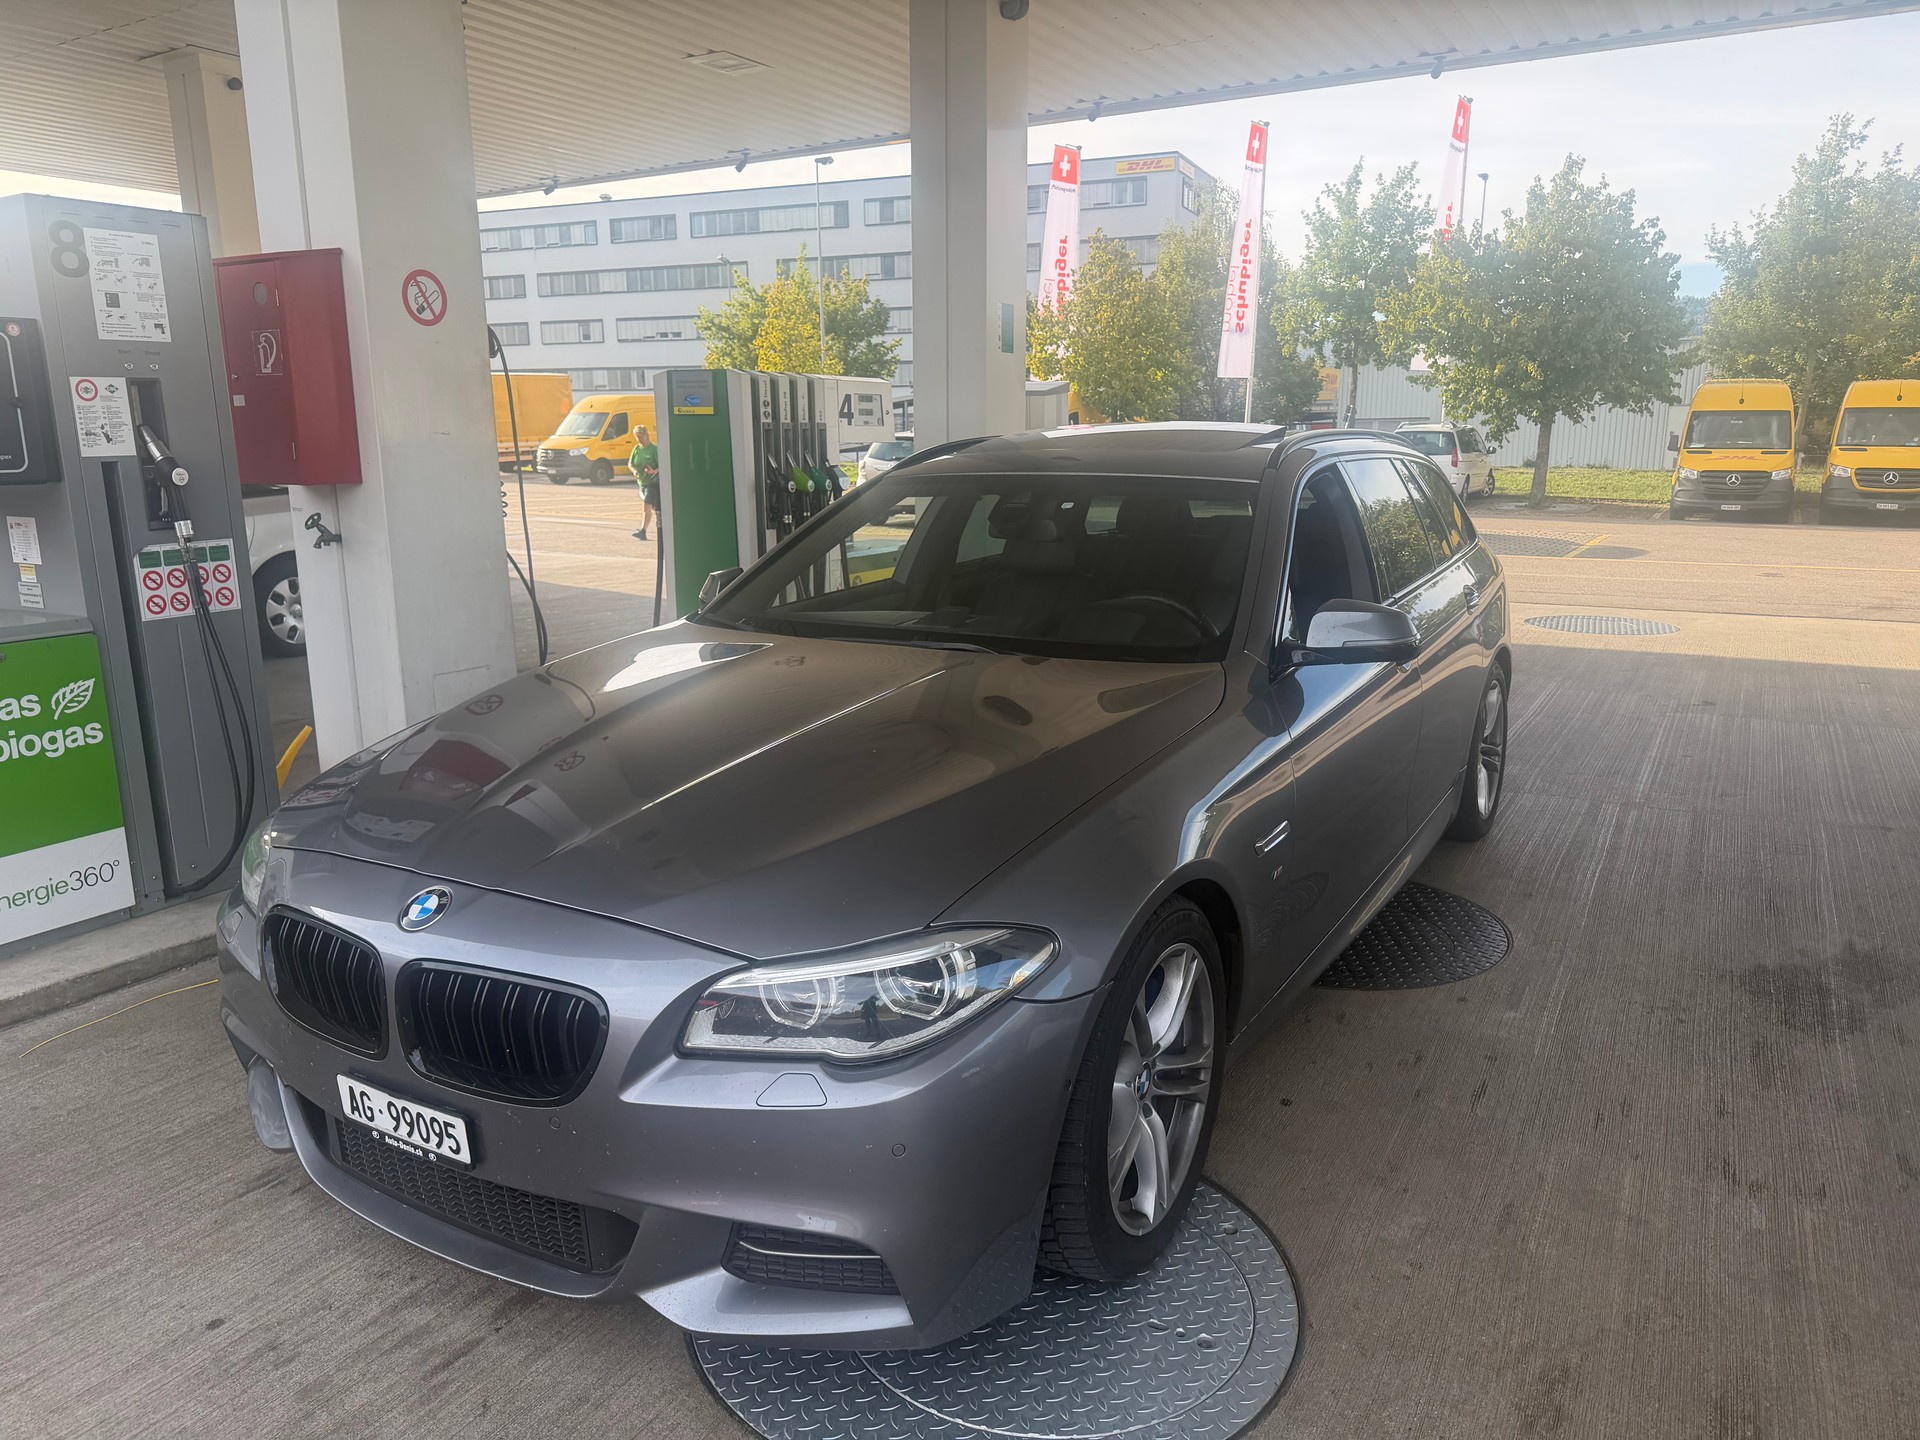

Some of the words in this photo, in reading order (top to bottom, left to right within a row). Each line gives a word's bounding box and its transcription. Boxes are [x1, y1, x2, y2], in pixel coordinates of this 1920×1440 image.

[1126, 159, 1165, 171] DHL
[48, 219, 90, 278] 8
[839, 393, 854, 425] 4
